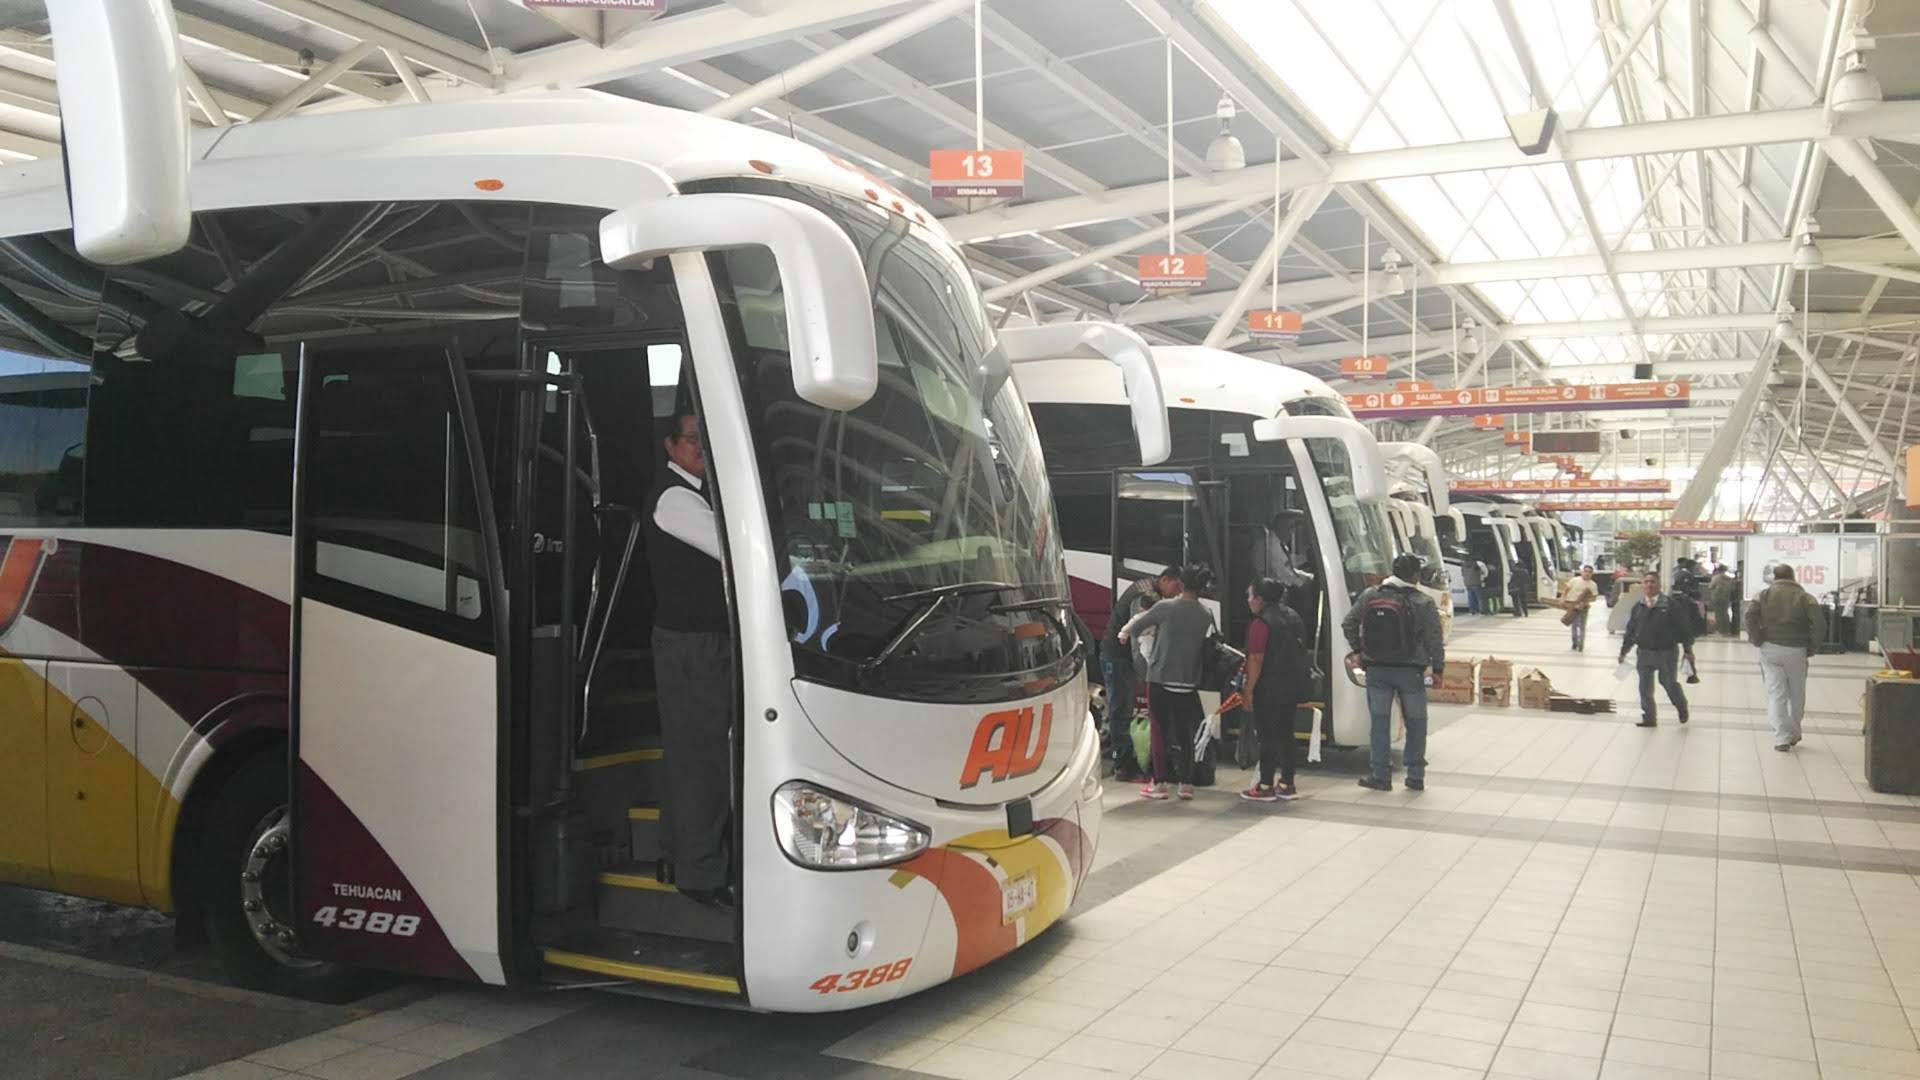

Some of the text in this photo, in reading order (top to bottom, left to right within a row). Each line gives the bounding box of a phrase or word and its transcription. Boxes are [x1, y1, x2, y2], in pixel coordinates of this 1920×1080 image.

[961, 154, 994, 178] 13
[1158, 257, 1185, 275] 12
[1263, 314, 1283, 329] 11
[1354, 358, 1373, 371] 10
[959, 702, 1053, 790] AU
[332, 883, 402, 902] TEHUACAN
[312, 905, 421, 937] 4388
[808, 956, 913, 995] 4388
